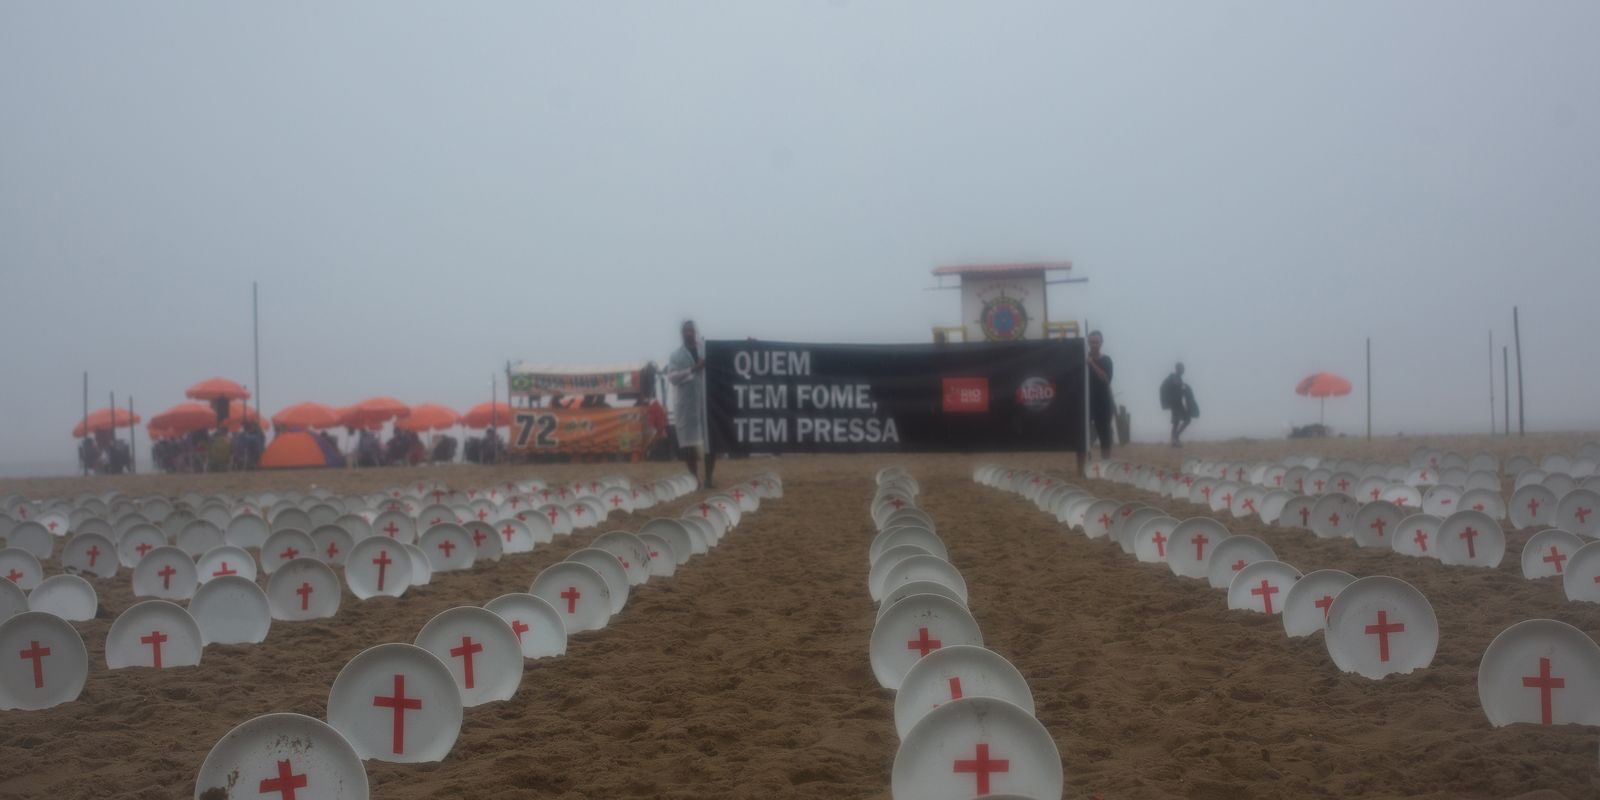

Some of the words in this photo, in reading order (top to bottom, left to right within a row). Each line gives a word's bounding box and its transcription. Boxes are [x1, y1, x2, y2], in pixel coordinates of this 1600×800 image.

[734, 351, 811, 379] QUEM
[733, 384, 787, 409] TEM
[797, 384, 877, 413] FOME,
[515, 412, 559, 448] 72
[733, 418, 787, 443] TEM
[797, 418, 900, 443] PRESSA
